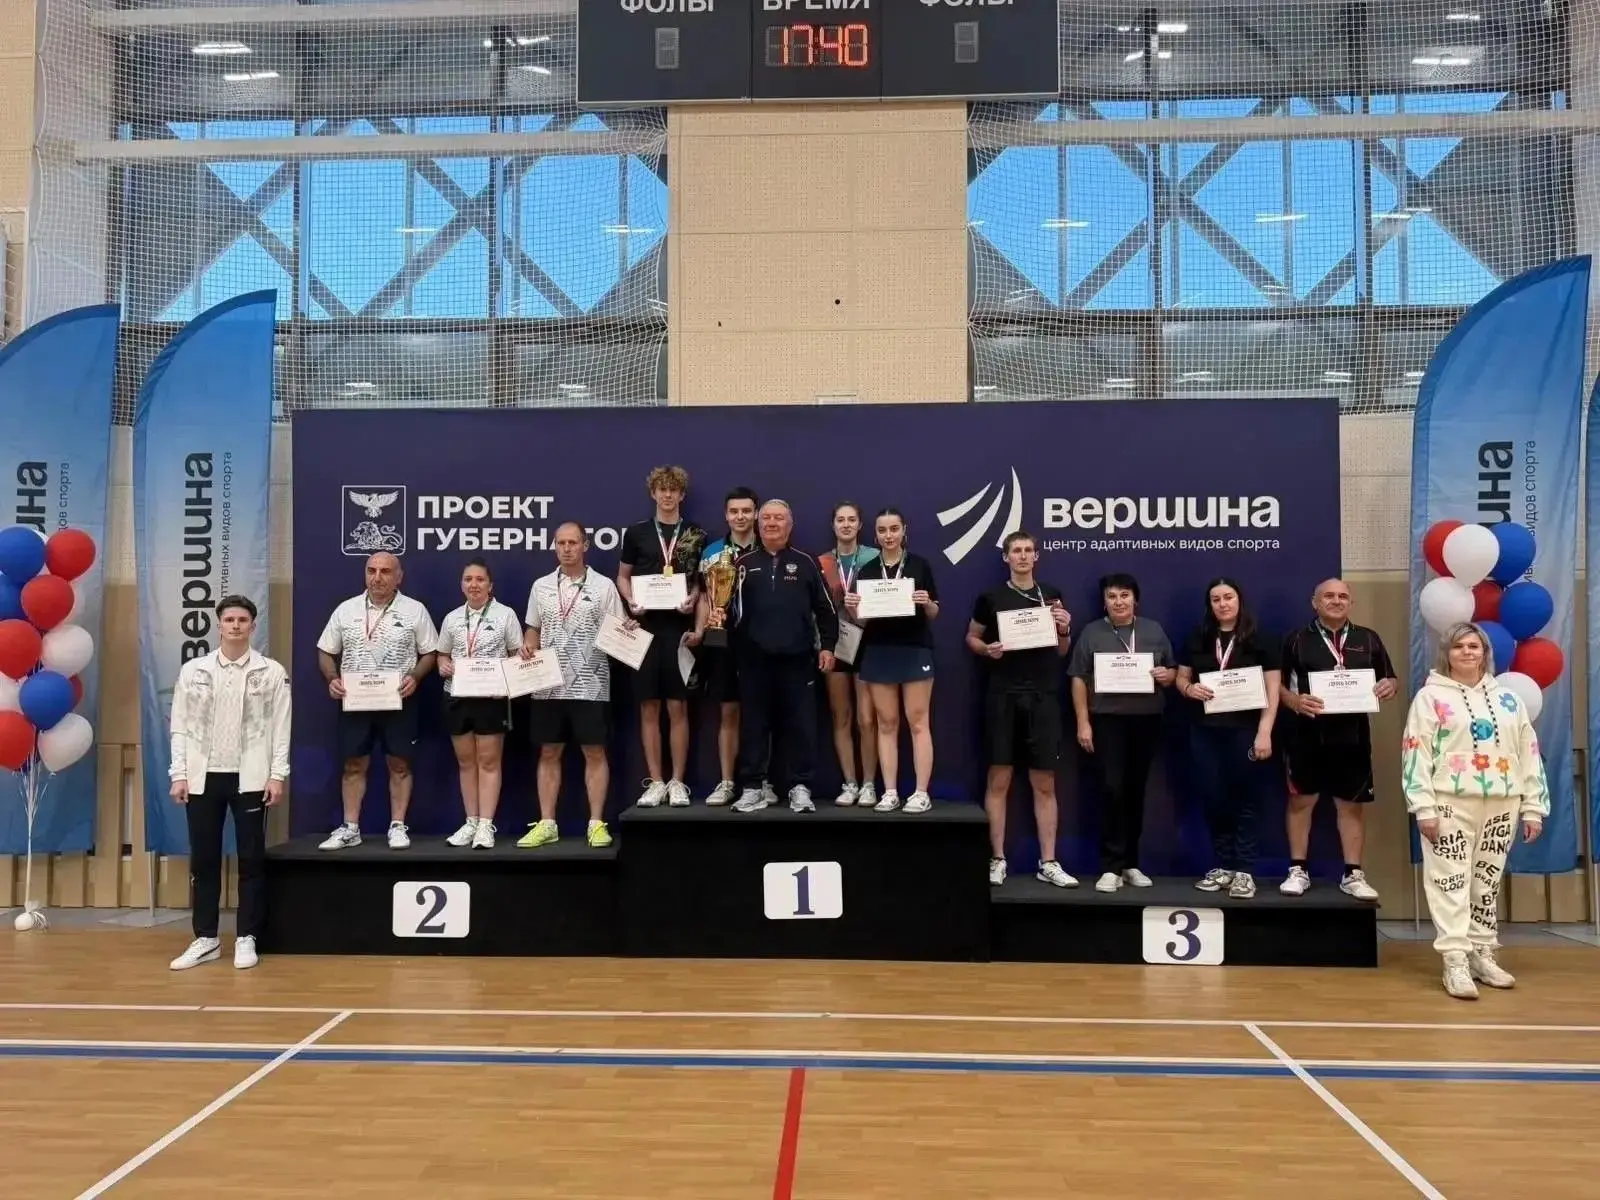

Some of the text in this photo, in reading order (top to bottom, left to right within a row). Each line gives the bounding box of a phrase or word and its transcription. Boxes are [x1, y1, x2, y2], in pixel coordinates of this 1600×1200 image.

[222, 452, 233, 499] спорта
[1525, 440, 1539, 490] спорта
[221, 502, 232, 541] видов
[418, 495, 554, 519] ПРОЕКТ
[1043, 495, 1280, 534] вершина
[417, 527, 627, 551] ГУБЕРНО
[1043, 539, 1280, 552] центр адаптивных видов спорта
[415, 885, 448, 934] 2
[791, 865, 816, 916] 1
[1166, 909, 1202, 961] 3
